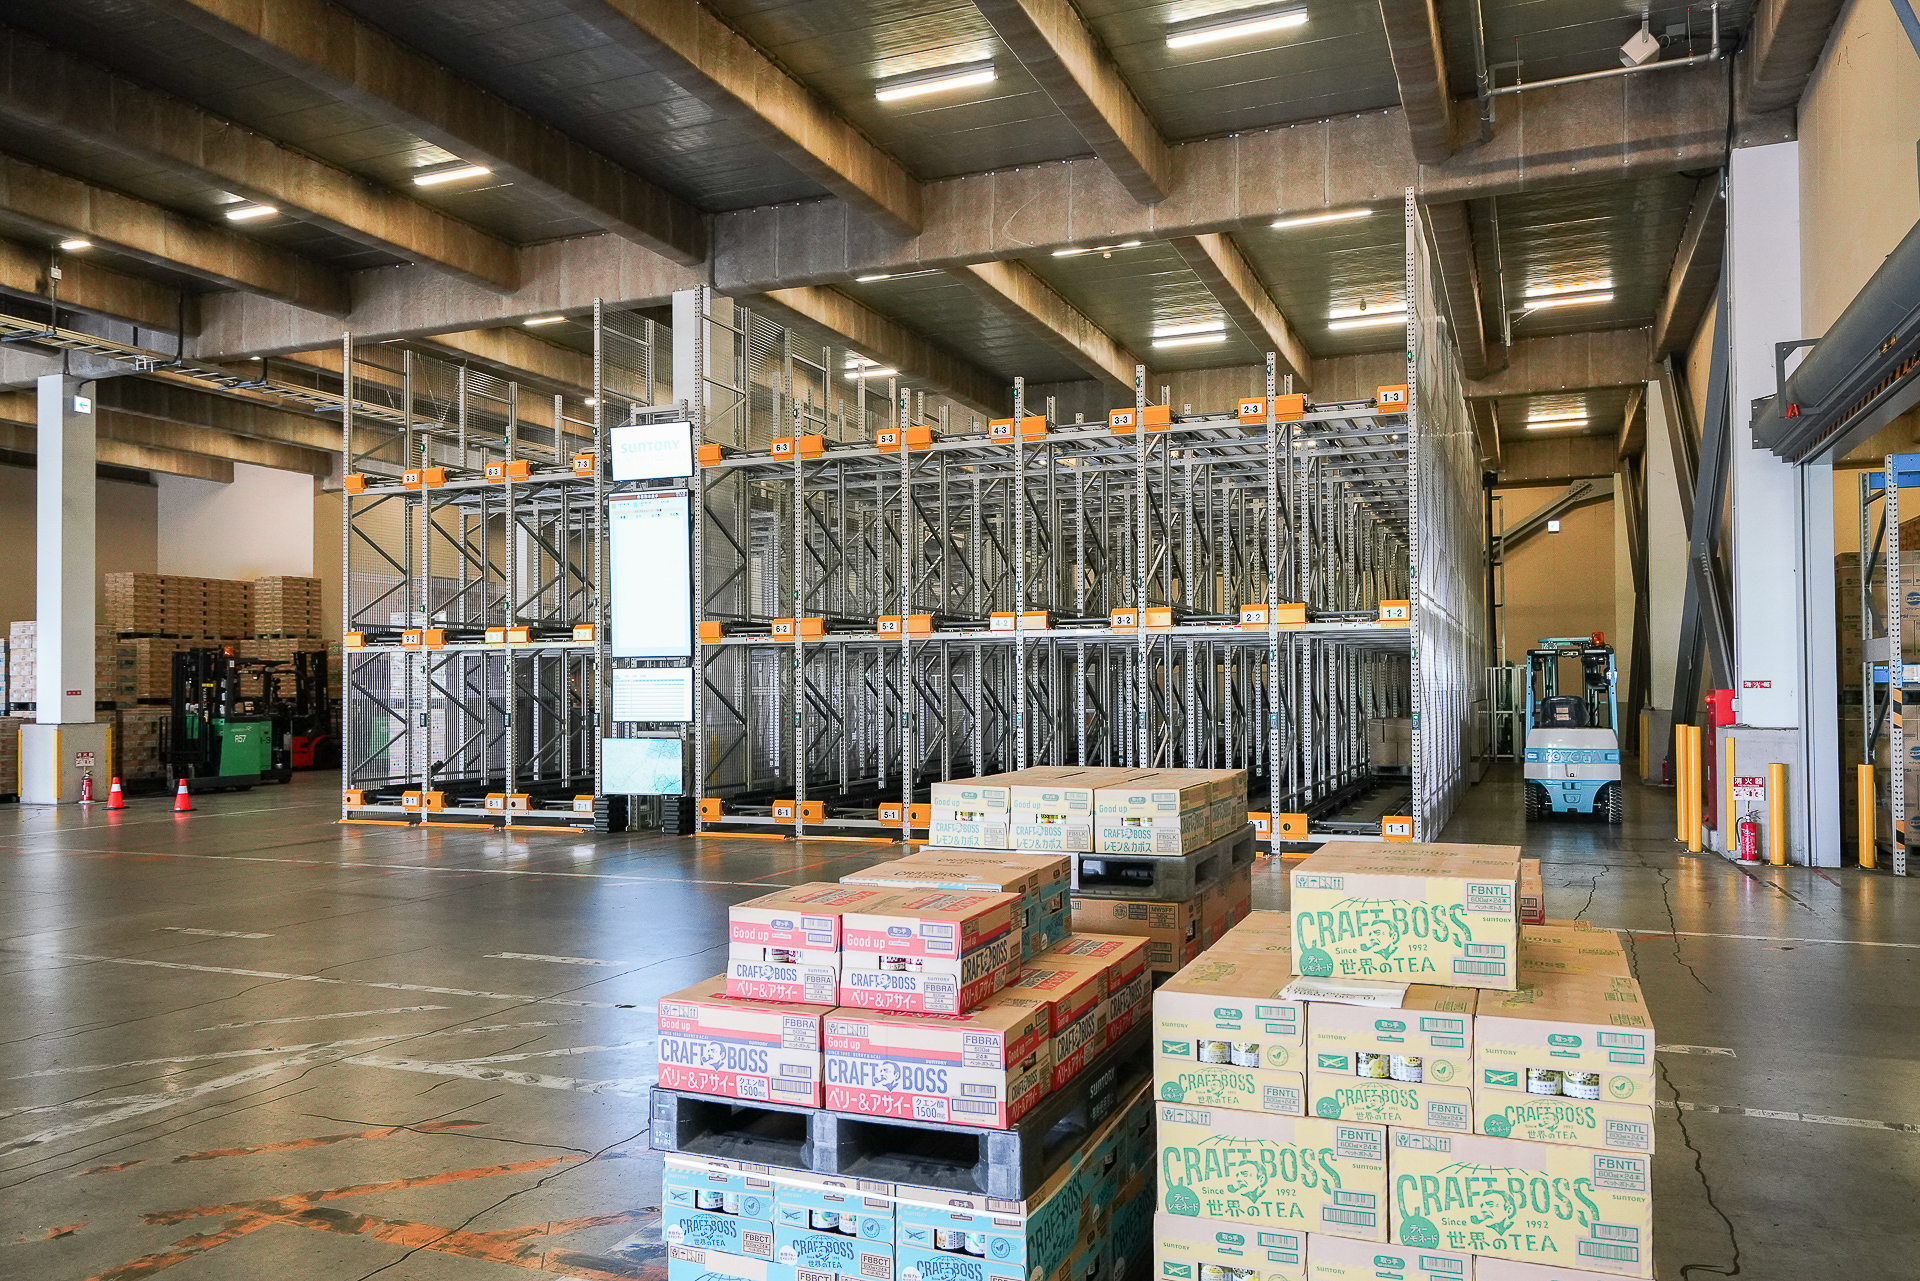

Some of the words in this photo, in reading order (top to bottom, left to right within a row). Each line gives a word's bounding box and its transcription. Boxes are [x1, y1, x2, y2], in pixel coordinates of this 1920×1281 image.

[1383, 392, 1399, 402] 1-3
[1243, 405, 1258, 414] 2-3
[1114, 415, 1128, 425] 3-3
[993, 426, 1007, 435] 4-3
[881, 434, 894, 443] 5-3
[621, 439, 680, 454] SUNTORY
[775, 443, 788, 452] 6-3
[1246, 613, 1261, 622] 2-2
[1386, 608, 1403, 618] 1-2
[995, 619, 1008, 627] 4-2
[1117, 616, 1131, 624] 3-2
[775, 625, 787, 633] 6-2
[882, 622, 894, 630] 5-2
[406, 635, 415, 643] 9-2
[1543, 750, 1602, 763] TOYOTA
[934, 797, 950, 806] Good
[952, 799, 960, 807] up
[1014, 800, 1031, 809] Good
[1032, 802, 1041, 810] up
[777, 808, 788, 816] 6-1
[1099, 804, 1117, 813] Good
[1118, 806, 1128, 814] up
[883, 811, 895, 819] 5-1
[936, 822, 955, 833] CRAFT
[963, 824, 979, 833] BOSS
[1016, 826, 1036, 836] CRAFT
[1044, 827, 1062, 837] BOSS
[1388, 824, 1404, 833] 1-1
[1103, 828, 1124, 839] CRAFT
[1133, 829, 1152, 839] BOSS
[936, 835, 980, 846] レモン&カボス
[1016, 838, 1062, 849] レモン&カボス
[1103, 841, 1152, 853] レモン&カボス
[1470, 885, 1508, 896] FBNTL
[1474, 904, 1504, 912] ペットボトル
[1296, 909, 1384, 953] CRAFT
[1392, 903, 1472, 948] BOSS
[733, 926, 756, 939] Good
[758, 931, 769, 942] up
[847, 934, 871, 947] Good
[873, 938, 886, 950] up
[1335, 946, 1358, 955] Since
[1408, 943, 1428, 952] 1992
[962, 951, 984, 985] CRAFT
[992, 940, 1007, 969] BOSS
[1307, 955, 1323, 963] ティー
[1301, 963, 1332, 972] レモネード
[1339, 956, 1436, 975] 世界のTEA
[736, 964, 763, 980] CRAFT
[774, 967, 797, 982] BOSS
[851, 972, 879, 988] CRAFT
[891, 976, 916, 990] BOSS
[736, 980, 798, 999] ベリー&アサイー
[925, 984, 953, 992] FBBRA
[851, 990, 917, 1009] ベリー&アサイー
[661, 1017, 680, 1030] Good
[681, 1021, 691, 1032] up
[784, 1018, 815, 1029] FBBRA
[965, 1035, 999, 1046] FBBRA
[1057, 1029, 1076, 1062] CRAFT
[1081, 1013, 1095, 1044] BOSS
[1317, 1033, 1347, 1041] SUNTORY
[828, 1036, 848, 1049] Good
[850, 1040, 861, 1051] up
[661, 1038, 707, 1066] CRAFT
[727, 1046, 768, 1074] BOSS
[1008, 1047, 1018, 1064] Good
[1018, 1043, 1025, 1057] up
[1485, 1048, 1517, 1056] SUNTORY
[661, 1067, 735, 1093] ベリー&アサイー
[828, 1058, 879, 1087] CRAFT
[902, 1066, 948, 1094] BOSS
[1089, 1067, 1115, 1099] SUNTORY
[1178, 1073, 1217, 1093] CRAFT
[1221, 1073, 1256, 1094] BOSS
[1266, 1088, 1296, 1098] FBNTL
[828, 1088, 911, 1115] ベリー&アサイー
[915, 1098, 944, 1108] クエン酸
[1335, 1088, 1377, 1109] CRAFT
[1381, 1089, 1419, 1110] BOSS
[916, 1106, 945, 1120] 1500mg
[1431, 1104, 1464, 1114] FBNTL
[1505, 1105, 1551, 1127] CRAFT
[1556, 1106, 1596, 1129] BOSS
[1609, 1122, 1645, 1134] FBNTL
[1340, 1129, 1378, 1142] FBNTL
[1344, 1149, 1374, 1158] ペットボトル
[1598, 1158, 1641, 1171] FBNTL
[1162, 1146, 1252, 1190] CRAFT
[1260, 1147, 1341, 1195] BOSS
[1602, 1179, 1637, 1188] ペットボトル
[1201, 1187, 1224, 1195] Since
[1276, 1188, 1297, 1197] 1992
[1174, 1194, 1190, 1202] ティー
[1397, 1174, 1498, 1220] CRAFT
[1508, 1177, 1600, 1227] BOSS
[1612, 1194, 1646, 1203] SUNTORY
[1168, 1202, 1198, 1211] レモネード
[1206, 1199, 1305, 1219] 世界のTEA
[679, 1218, 709, 1236] CRAFT
[713, 1219, 737, 1238] BOSS
[1441, 1217, 1467, 1226] Since
[1526, 1220, 1549, 1229] 1992
[1409, 1225, 1428, 1233] ティー
[745, 1233, 769, 1243] FBBCT
[1402, 1233, 1438, 1242] レモネード
[1446, 1230, 1558, 1252] 世界のTEA
[793, 1239, 824, 1258] CRAFT
[828, 1241, 855, 1261] BOSS
[1163, 1242, 1190, 1251] SUNTORY
[863, 1255, 889, 1266] FBBCT
[916, 1260, 950, 1279] CRAFT
[954, 1262, 983, 1281] BOSS
[1316, 1266, 1346, 1275] SUNTORY
